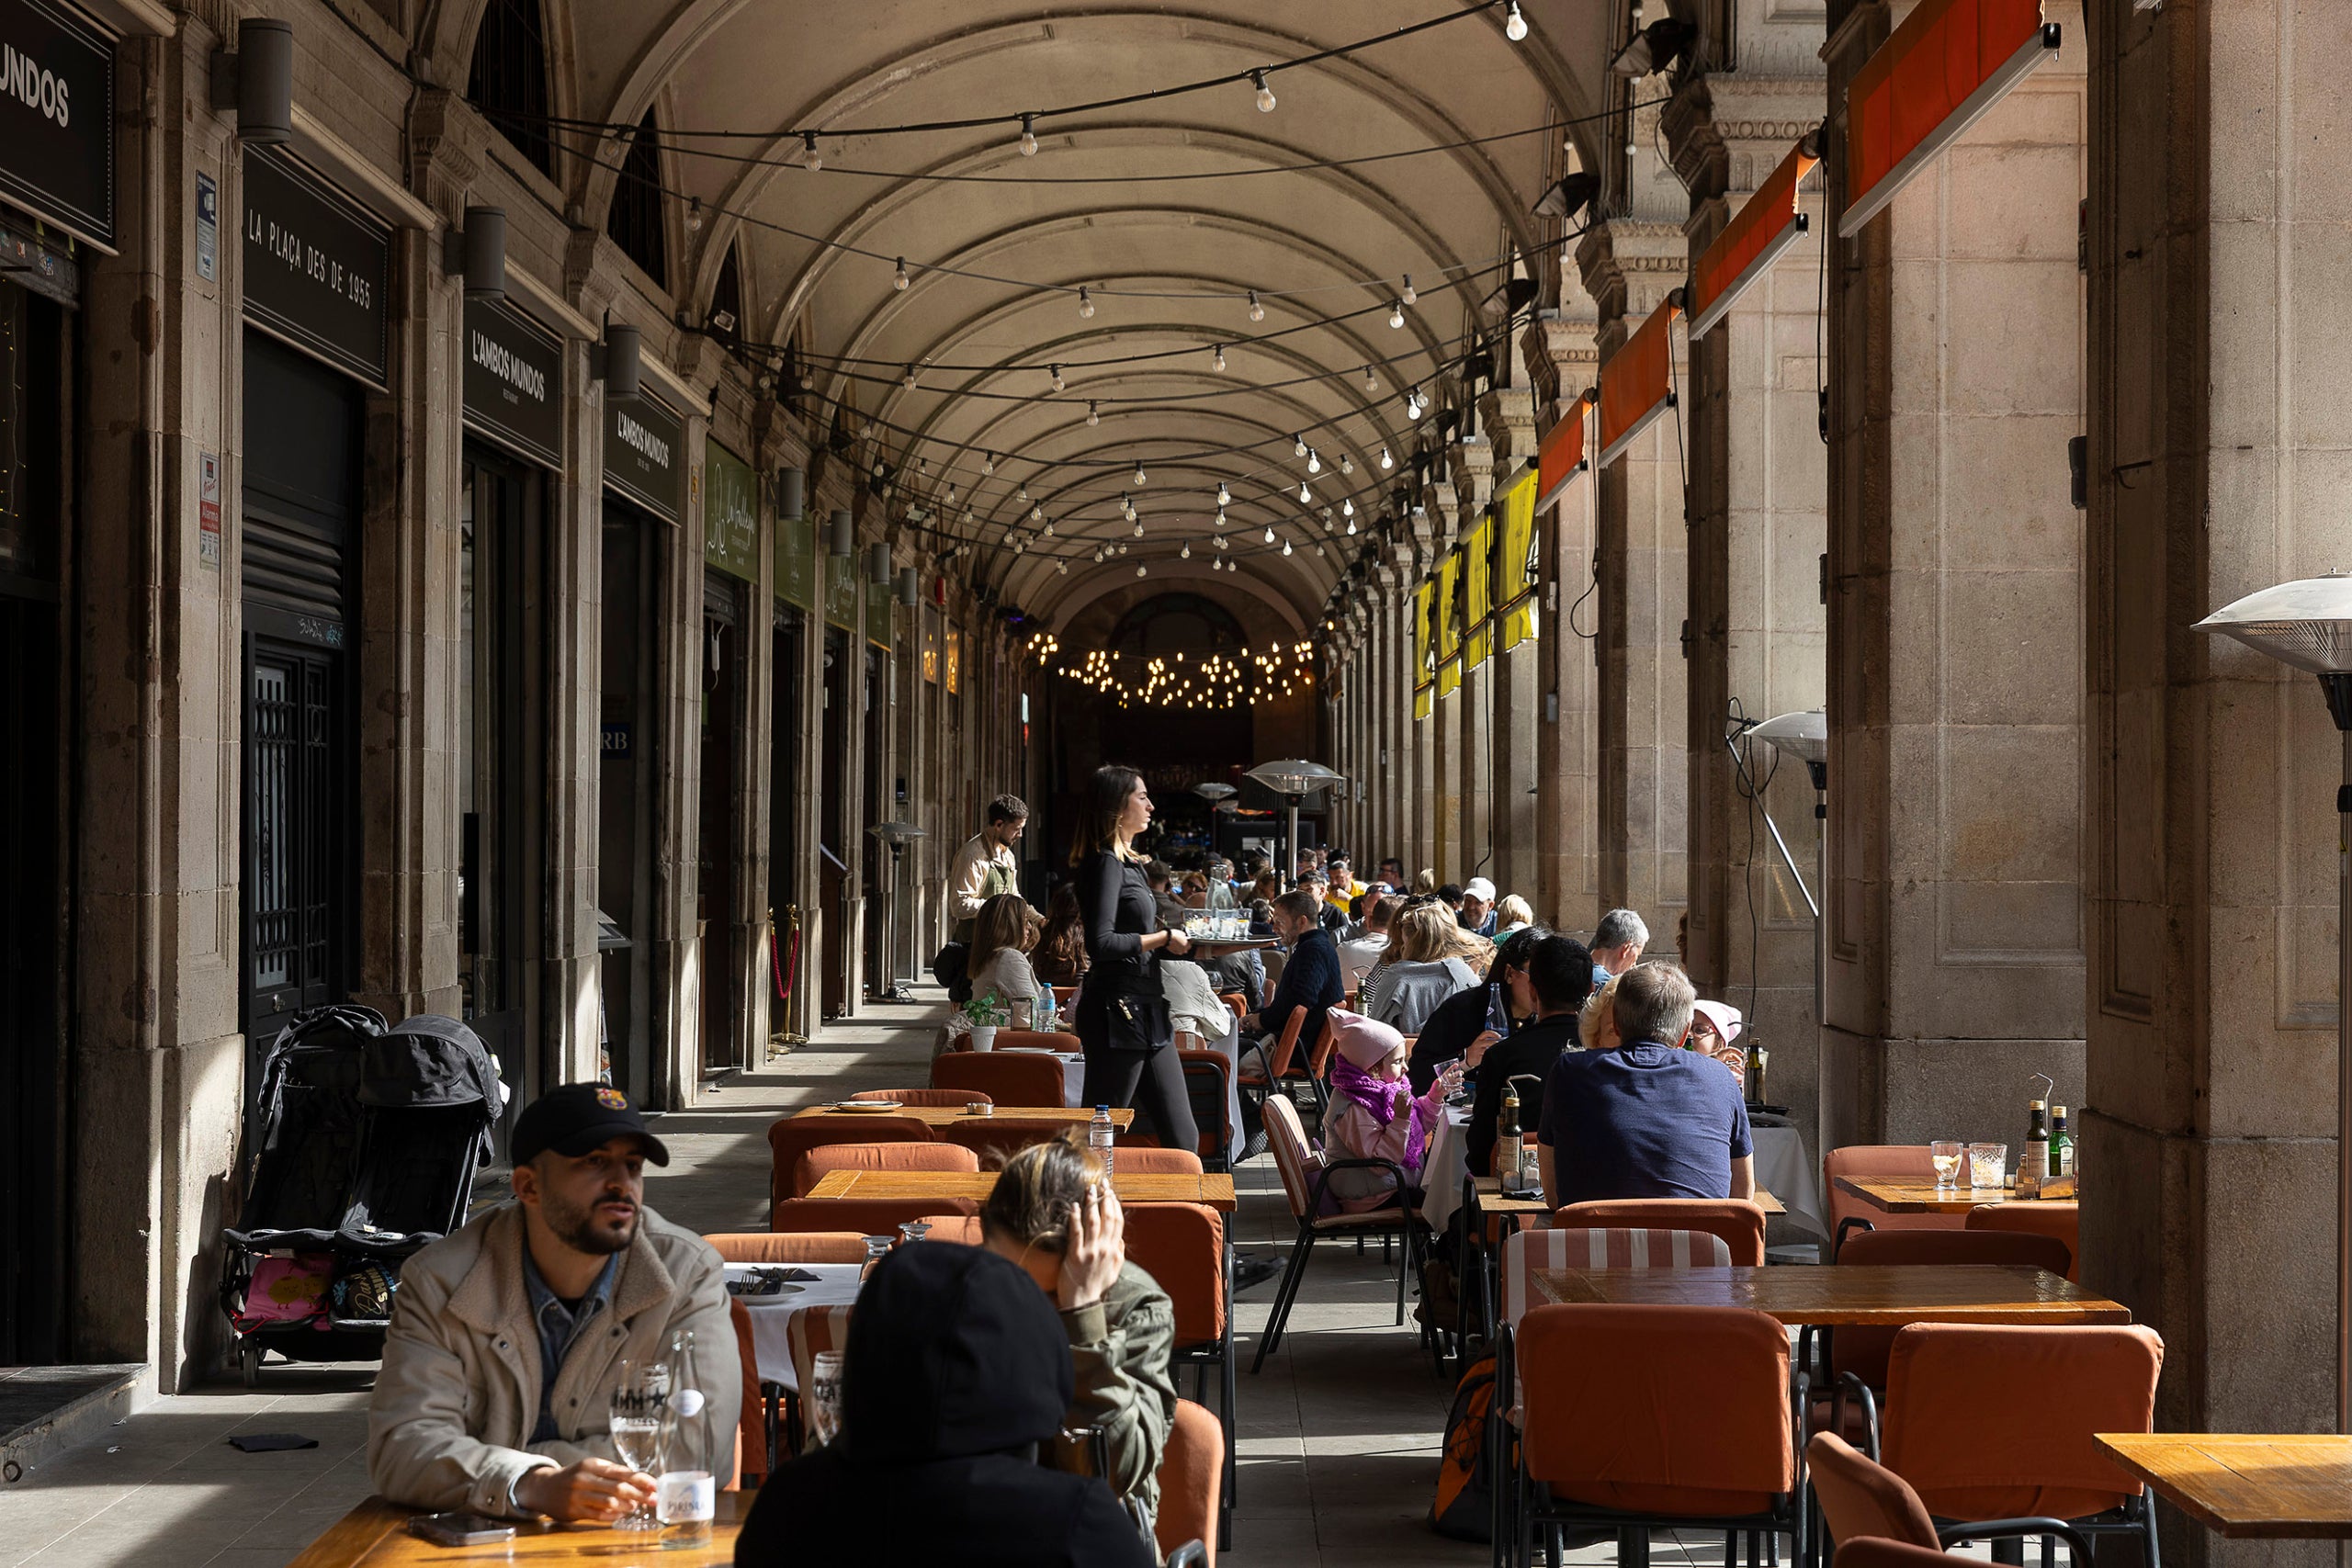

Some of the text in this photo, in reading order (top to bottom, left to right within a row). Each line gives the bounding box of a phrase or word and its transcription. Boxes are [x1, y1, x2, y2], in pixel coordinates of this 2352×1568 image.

[249, 209, 262, 245] LA
[269, 221, 300, 272] PLAÇA
[308, 245, 325, 283] DES
[332, 260, 343, 294] DE
[348, 272, 370, 310] 1955
[473, 329, 545, 402] L'AMBOS MUNDOS
[618, 411, 669, 469] L'AMBOS MUNDOS
[601, 731, 628, 750] RB
